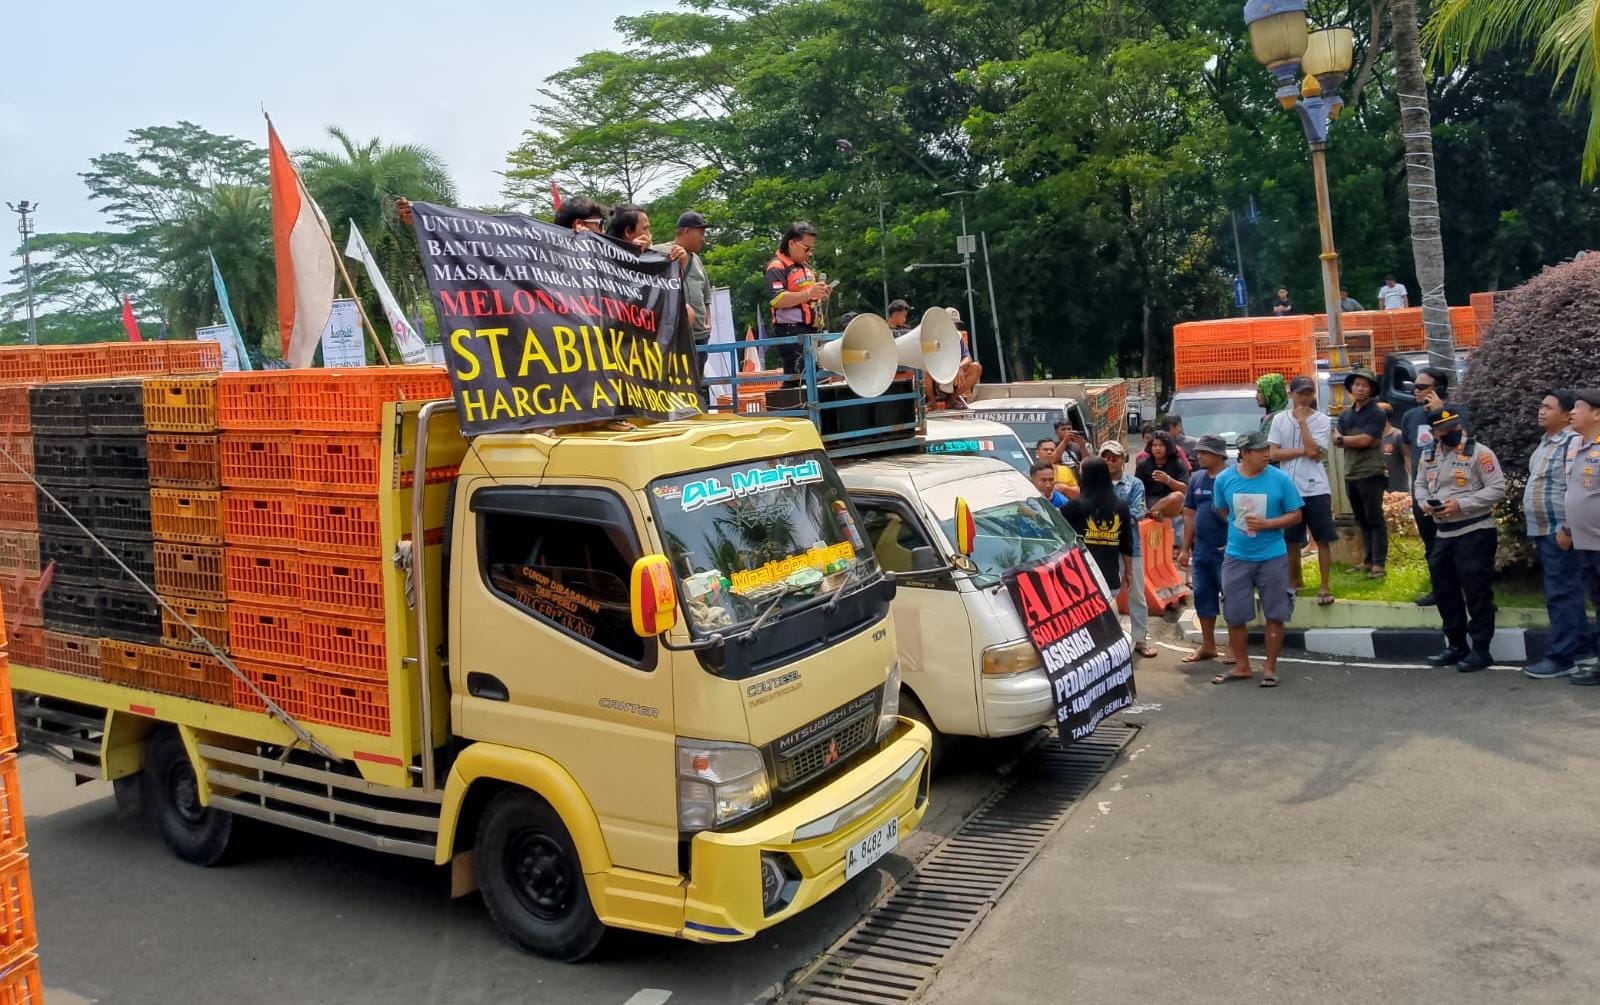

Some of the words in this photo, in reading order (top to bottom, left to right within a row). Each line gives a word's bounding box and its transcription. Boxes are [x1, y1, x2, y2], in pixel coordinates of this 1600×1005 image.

[422, 214, 489, 236] UNTUK
[491, 221, 543, 241] DINAS
[541, 229, 597, 254] TERKAIT
[427, 239, 549, 263] BANTUANNYA
[548, 249, 596, 271] UNTUK
[432, 264, 530, 281] MASALAH
[531, 266, 582, 289] HARGA
[581, 275, 617, 294] AYAM
[615, 281, 643, 301] YANG
[440, 288, 604, 317] MELONJAK
[603, 296, 656, 332] TINGGI
[450, 325, 663, 383] STABILKAN
[462, 383, 583, 422] HARGA
[591, 379, 643, 409] AYAM
[682, 478, 735, 511] AL
[731, 459, 824, 496] Mahdi
[1016, 548, 1098, 627] AKSI
[1032, 594, 1107, 650] SOLIDARITAS
[1041, 627, 1096, 674] ASOSIASI
[1054, 651, 1111, 703] PEDAGANG
[599, 697, 659, 718] CANTER
[780, 711, 846, 749] MITSUBISHI
[848, 692, 876, 713] FUSO
[861, 830, 882, 858] 8482
